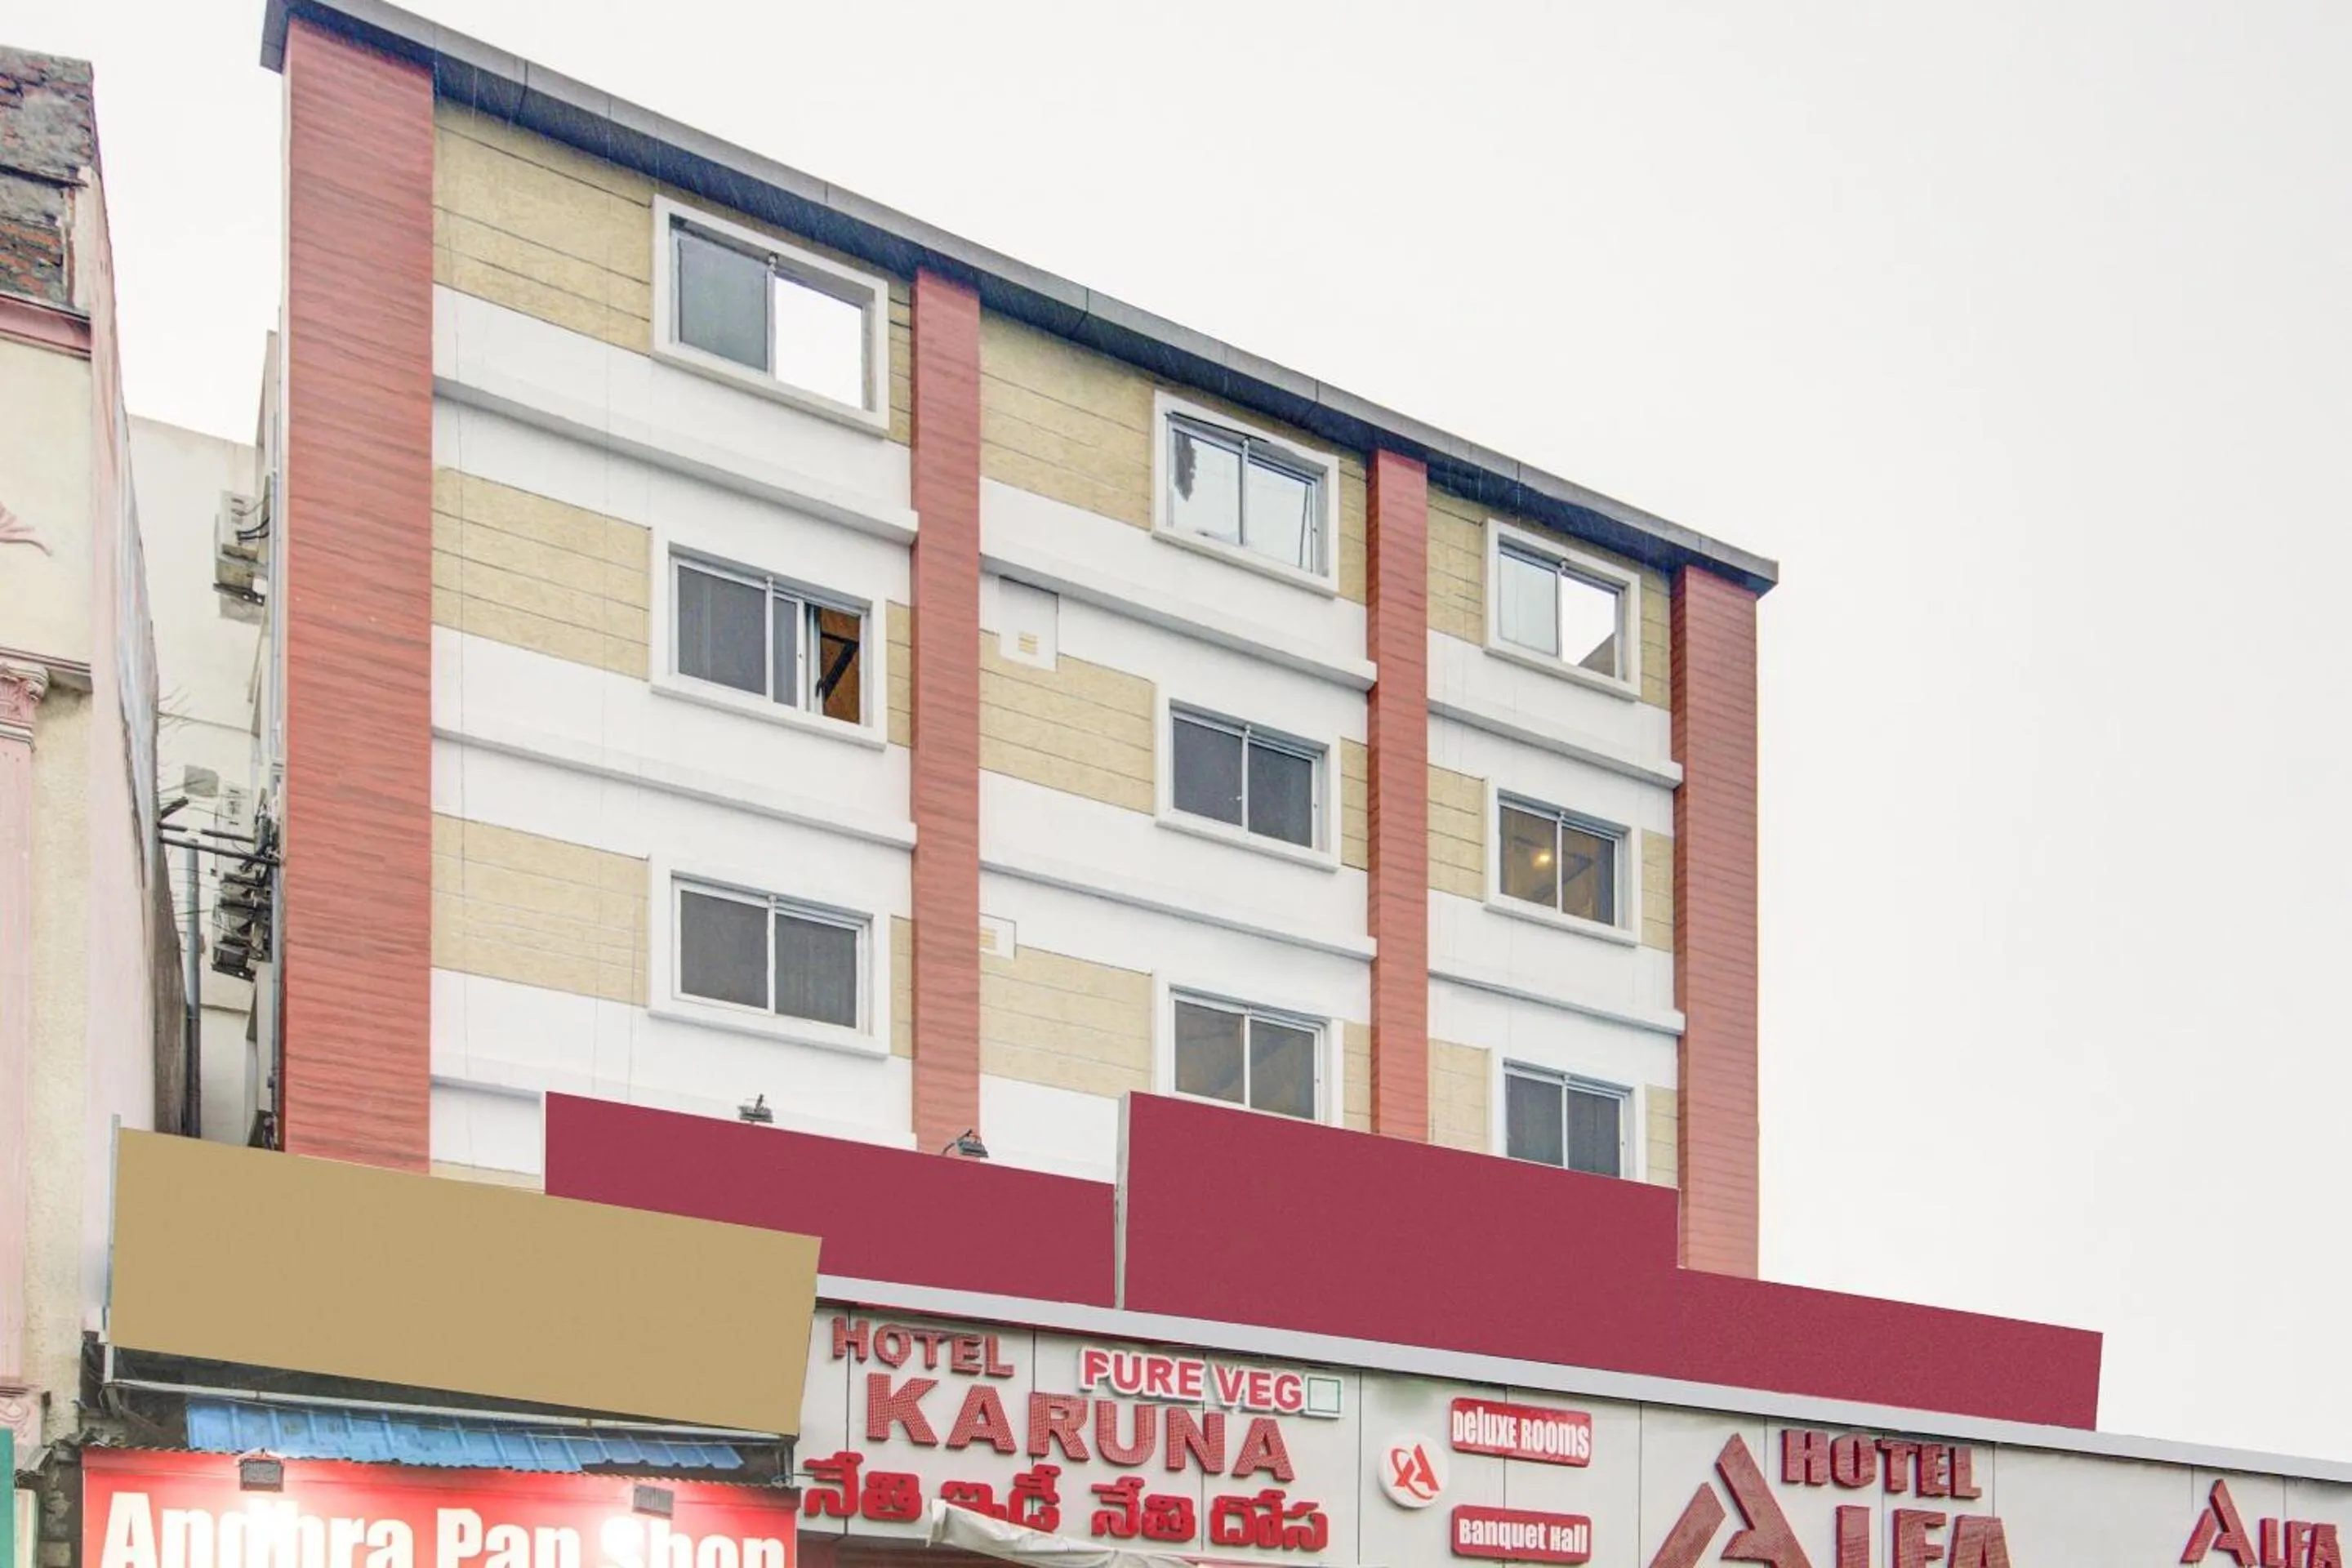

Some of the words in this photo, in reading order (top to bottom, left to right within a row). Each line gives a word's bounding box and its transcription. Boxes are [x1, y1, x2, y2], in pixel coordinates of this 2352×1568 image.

[831, 1316, 1014, 1377] HOTEL
[1083, 1349, 1205, 1399] PURE
[1214, 1364, 1304, 1411] VEG
[866, 1372, 1295, 1481] KARUNA
[1781, 1428, 1982, 1499] HOTEL
[100, 1490, 415, 1568] Andhra
[436, 1507, 581, 1568] Pan
[1459, 1518, 1546, 1549] Banquet
[1550, 1524, 1588, 1554] Hall
[1648, 1432, 2012, 1568] ALFA
[2180, 1478, 2342, 1568] ALFA
